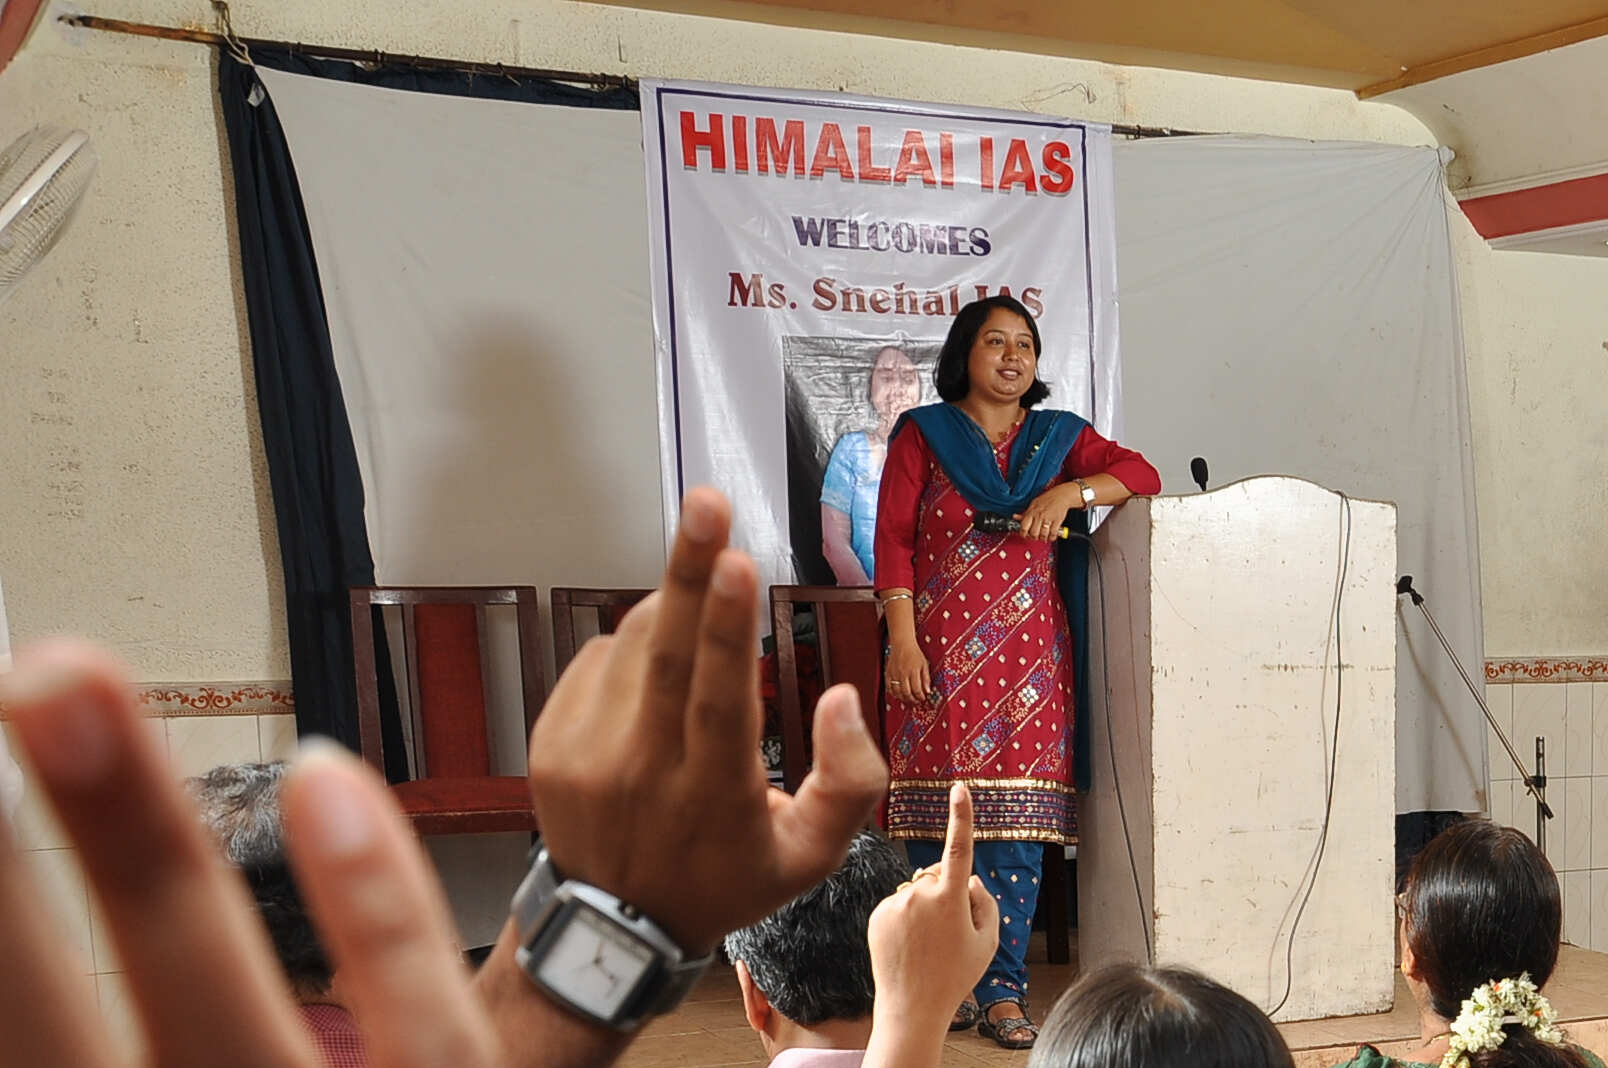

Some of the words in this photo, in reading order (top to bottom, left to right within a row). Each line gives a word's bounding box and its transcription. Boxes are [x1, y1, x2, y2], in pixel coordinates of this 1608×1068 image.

[679, 110, 955, 191] HIMALAI
[979, 135, 1075, 197] IAS
[791, 215, 992, 257] WELCOMES
[727, 271, 798, 309] Ms.
[811, 276, 960, 317] Snehal
